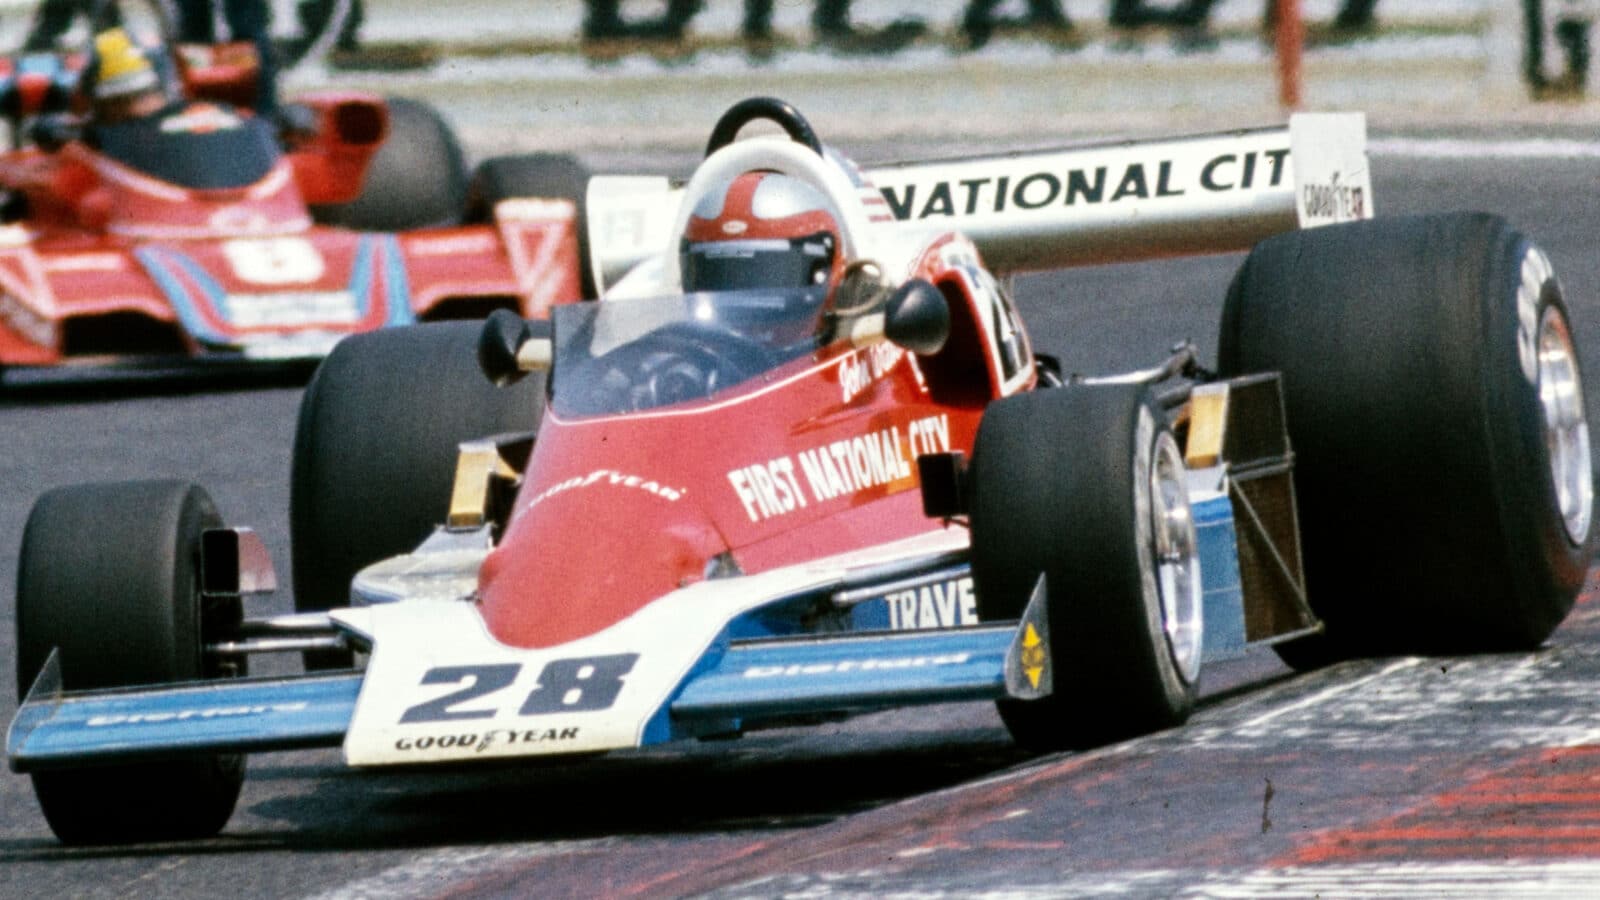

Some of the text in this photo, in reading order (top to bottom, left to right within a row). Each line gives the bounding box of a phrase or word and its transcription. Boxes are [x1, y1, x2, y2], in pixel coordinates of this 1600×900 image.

[879, 148, 1291, 221] NATIONAL CIT
[727, 413, 950, 523] FIRST NATIONAL CITY
[885, 577, 979, 631] TRAVE
[398, 653, 641, 725] 28
